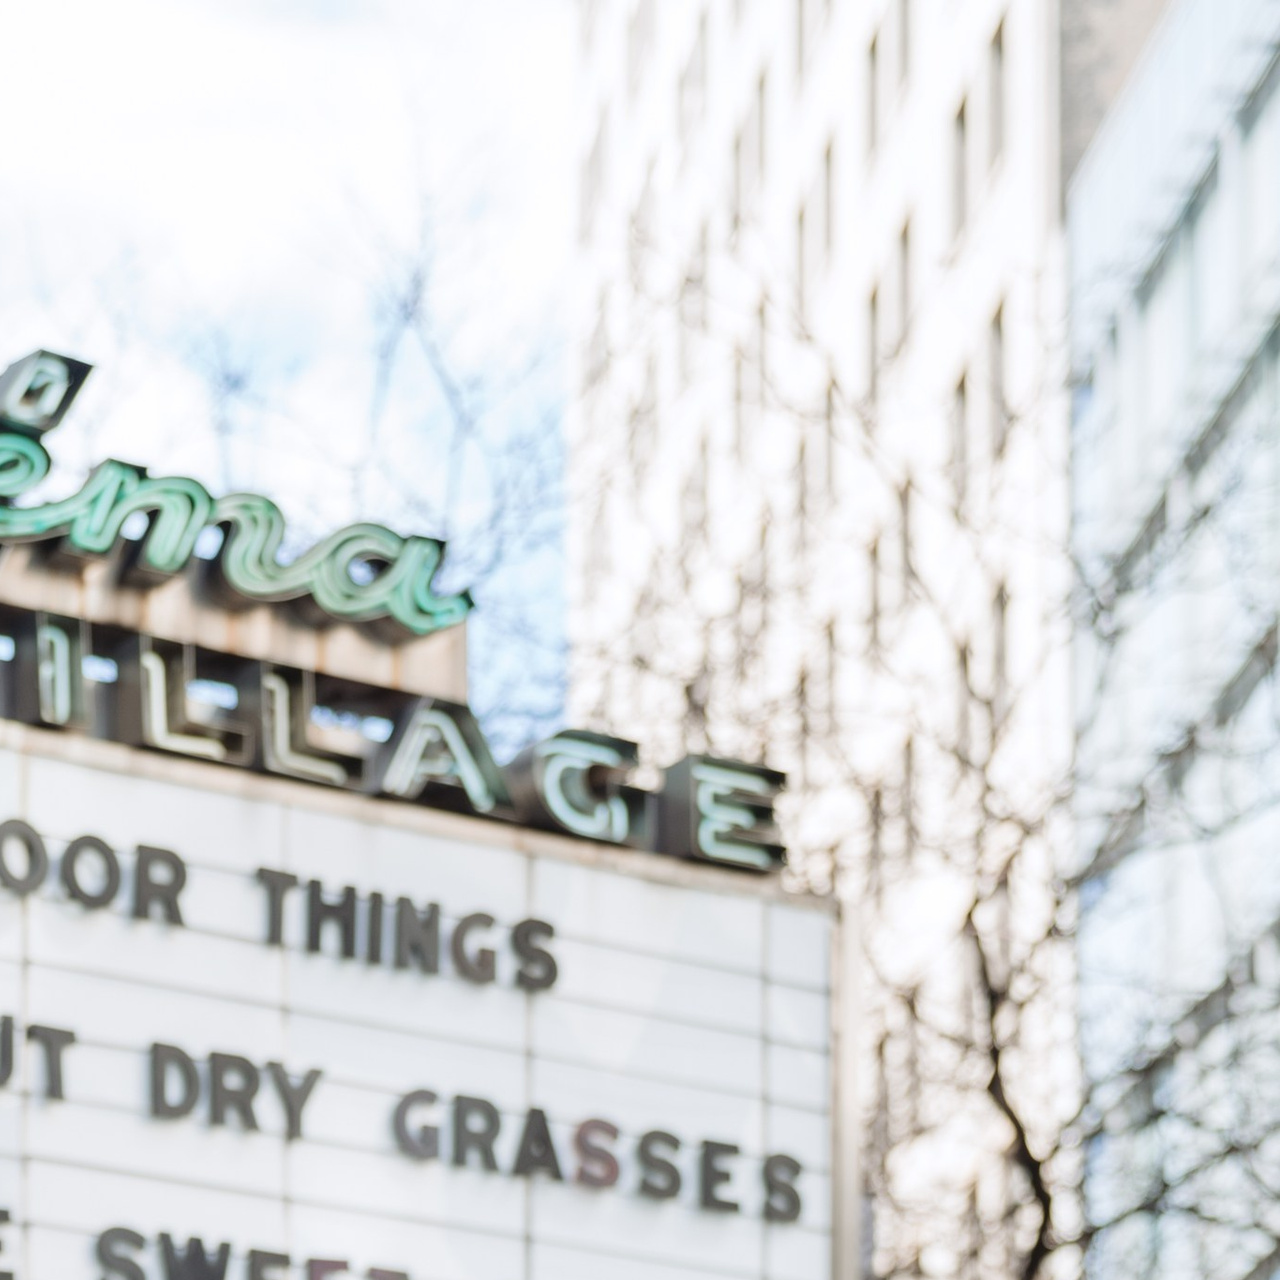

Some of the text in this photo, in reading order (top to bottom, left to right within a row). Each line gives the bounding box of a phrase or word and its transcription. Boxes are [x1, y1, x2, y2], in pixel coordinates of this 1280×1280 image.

[256, 868, 558, 993] THINGS
[149, 1041, 323, 1142] DRY
[392, 1087, 804, 1224] GRASSES
